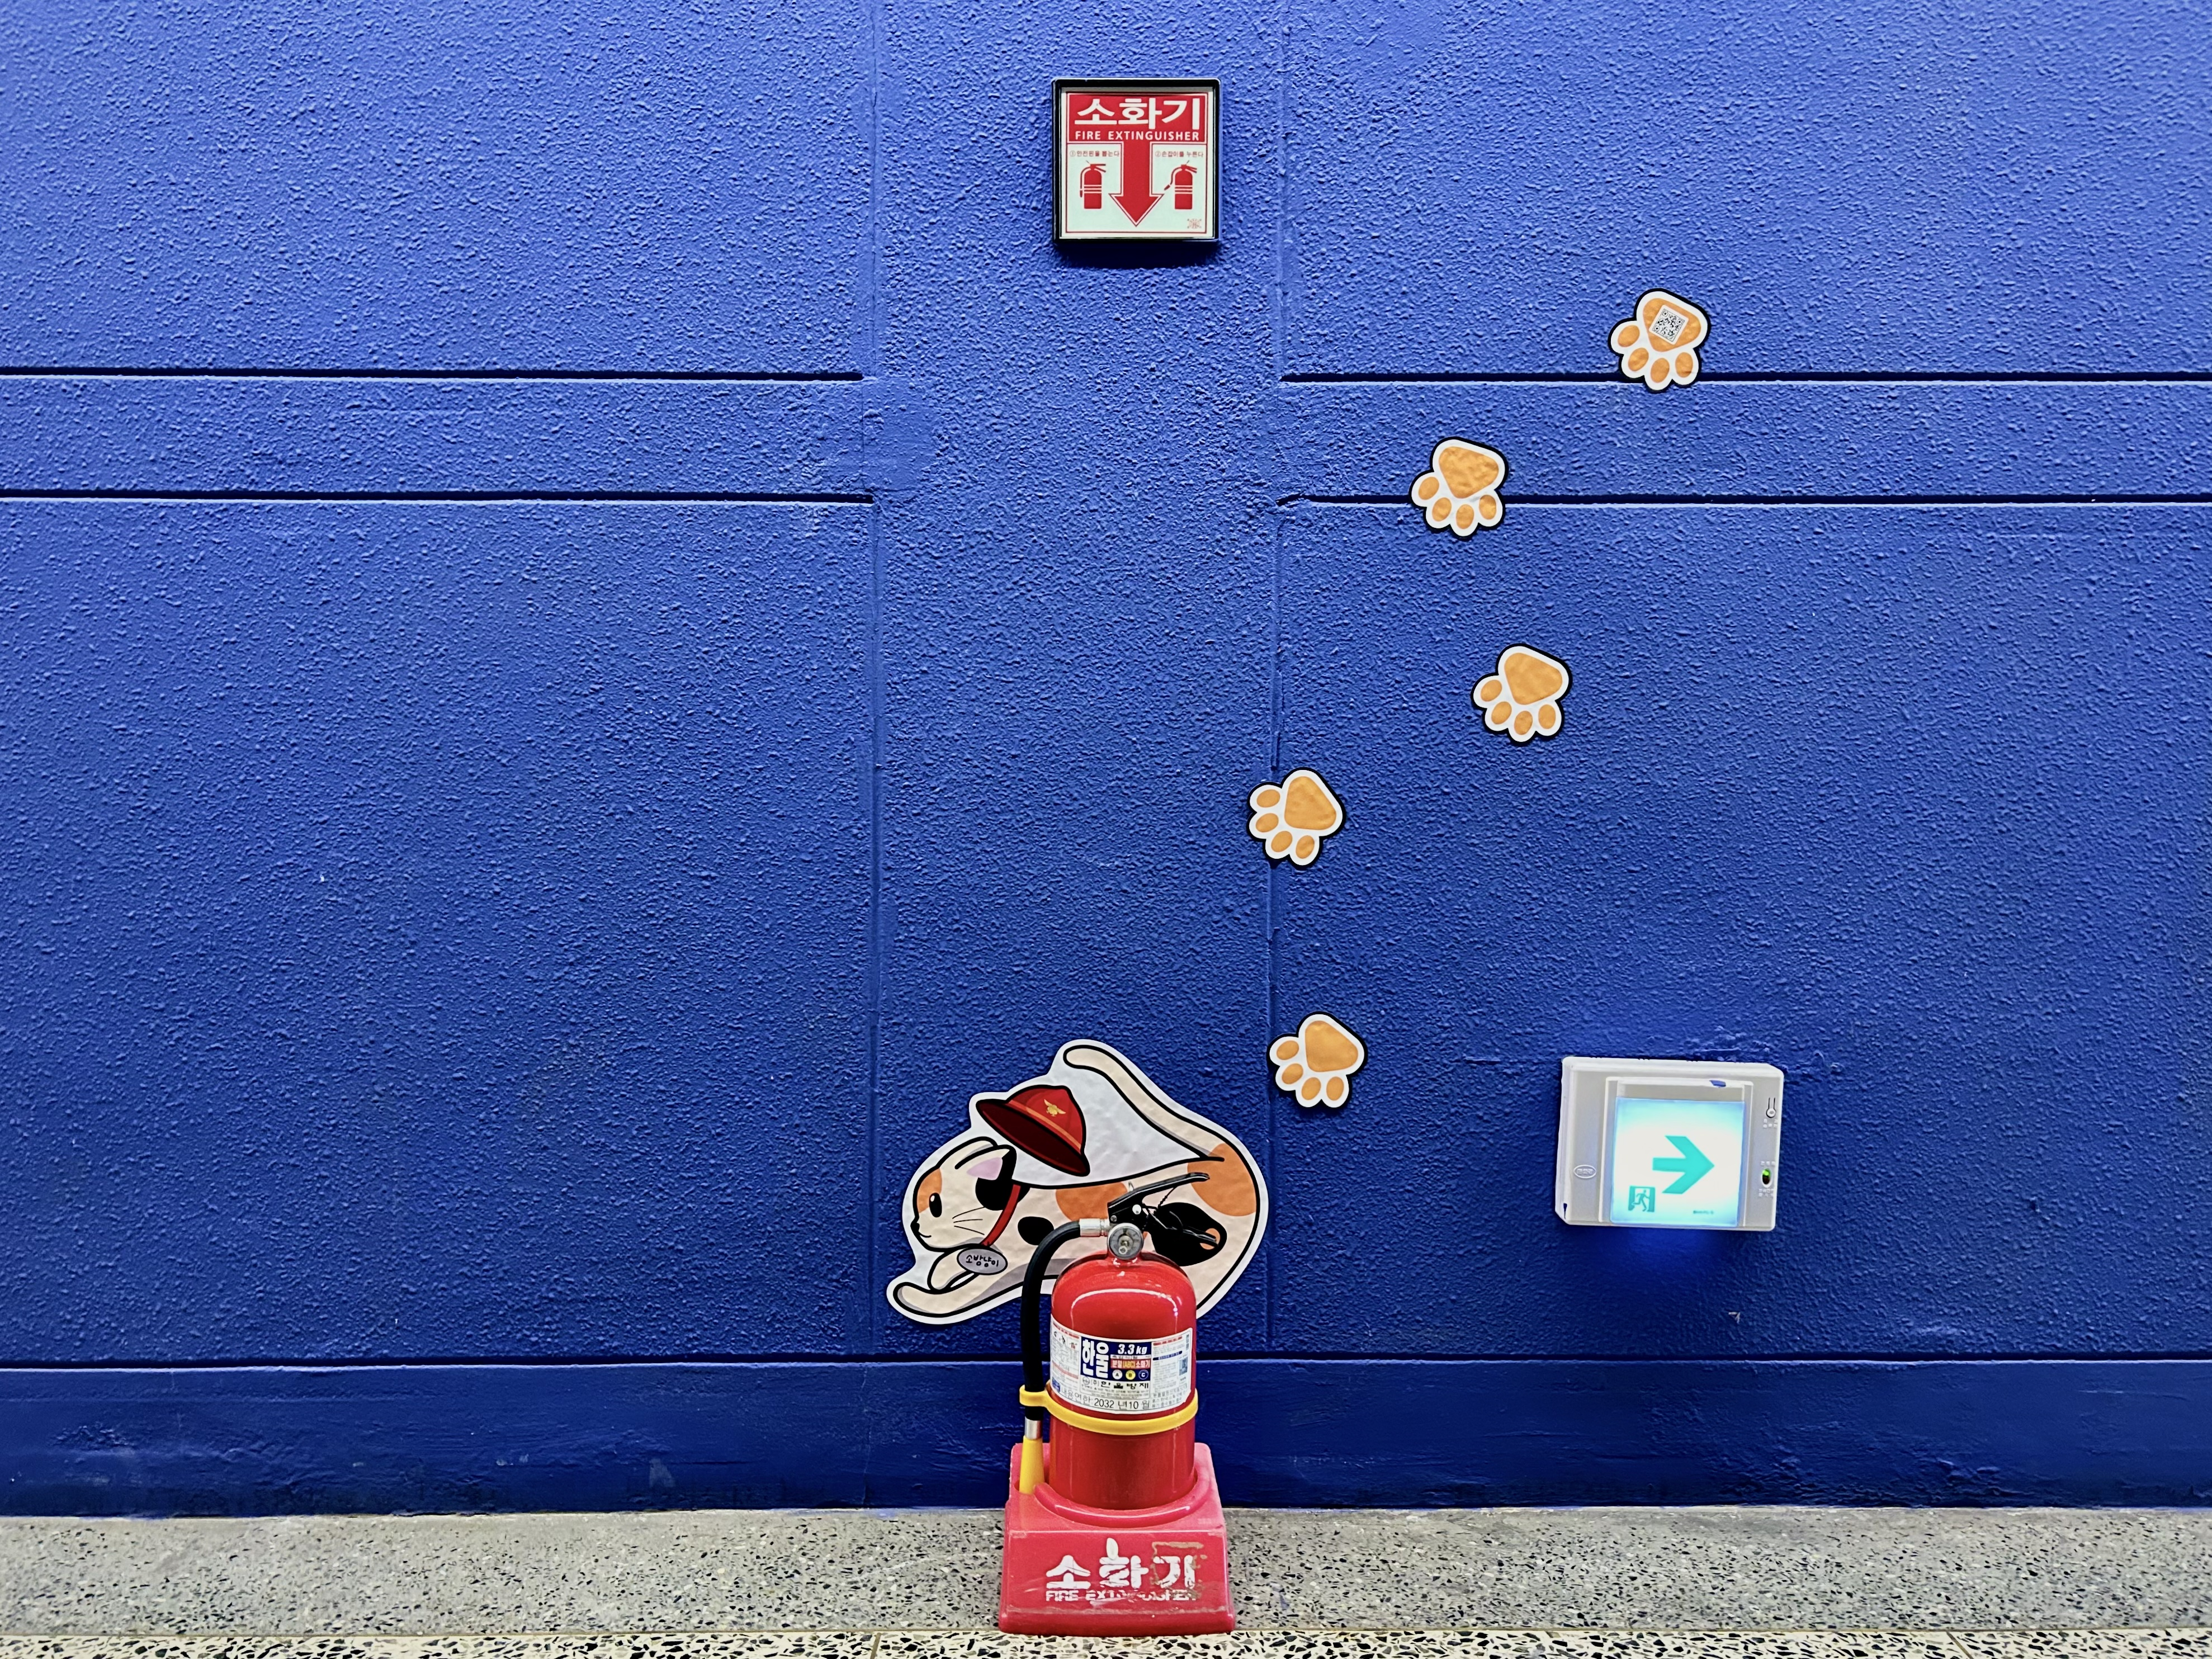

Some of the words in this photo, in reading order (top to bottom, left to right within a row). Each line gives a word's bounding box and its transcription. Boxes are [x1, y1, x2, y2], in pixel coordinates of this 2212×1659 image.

[1074, 98, 1200, 130] 소화기
[1075, 131, 1101, 140] FIRE
[1108, 131, 1199, 141] EXTINGUISHER
[966, 1255, 999, 1267] 소방냥이
[1082, 1339, 1109, 1378] 한울
[1094, 1398, 1114, 1409] 2032
[1046, 1538, 1195, 1589] 소화기
[1046, 1590, 1079, 1601] FIRE
